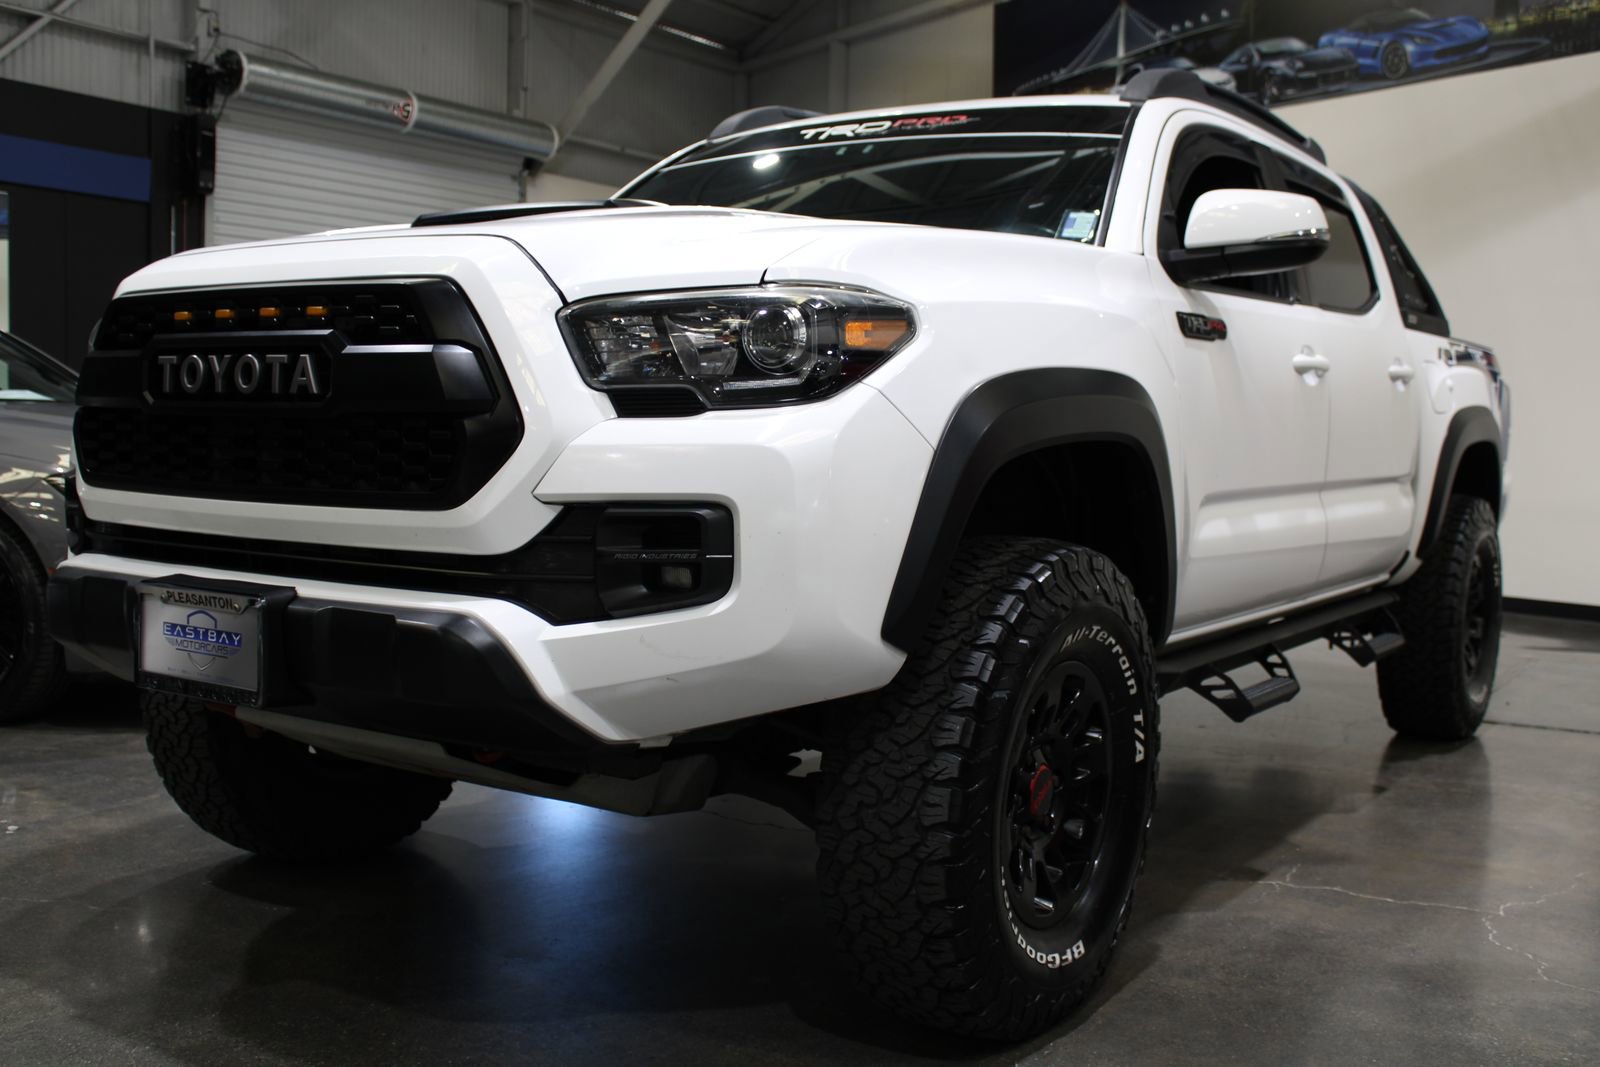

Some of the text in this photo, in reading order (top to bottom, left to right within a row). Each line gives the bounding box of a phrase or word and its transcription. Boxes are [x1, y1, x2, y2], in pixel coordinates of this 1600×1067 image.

[157, 353, 319, 394] TOYOTA
[166, 590, 234, 610] PLEASANTON
[163, 622, 241, 646] EASTBAY
[175, 638, 229, 655] MOTORCARS
[1133, 708, 1145, 763] T/A
